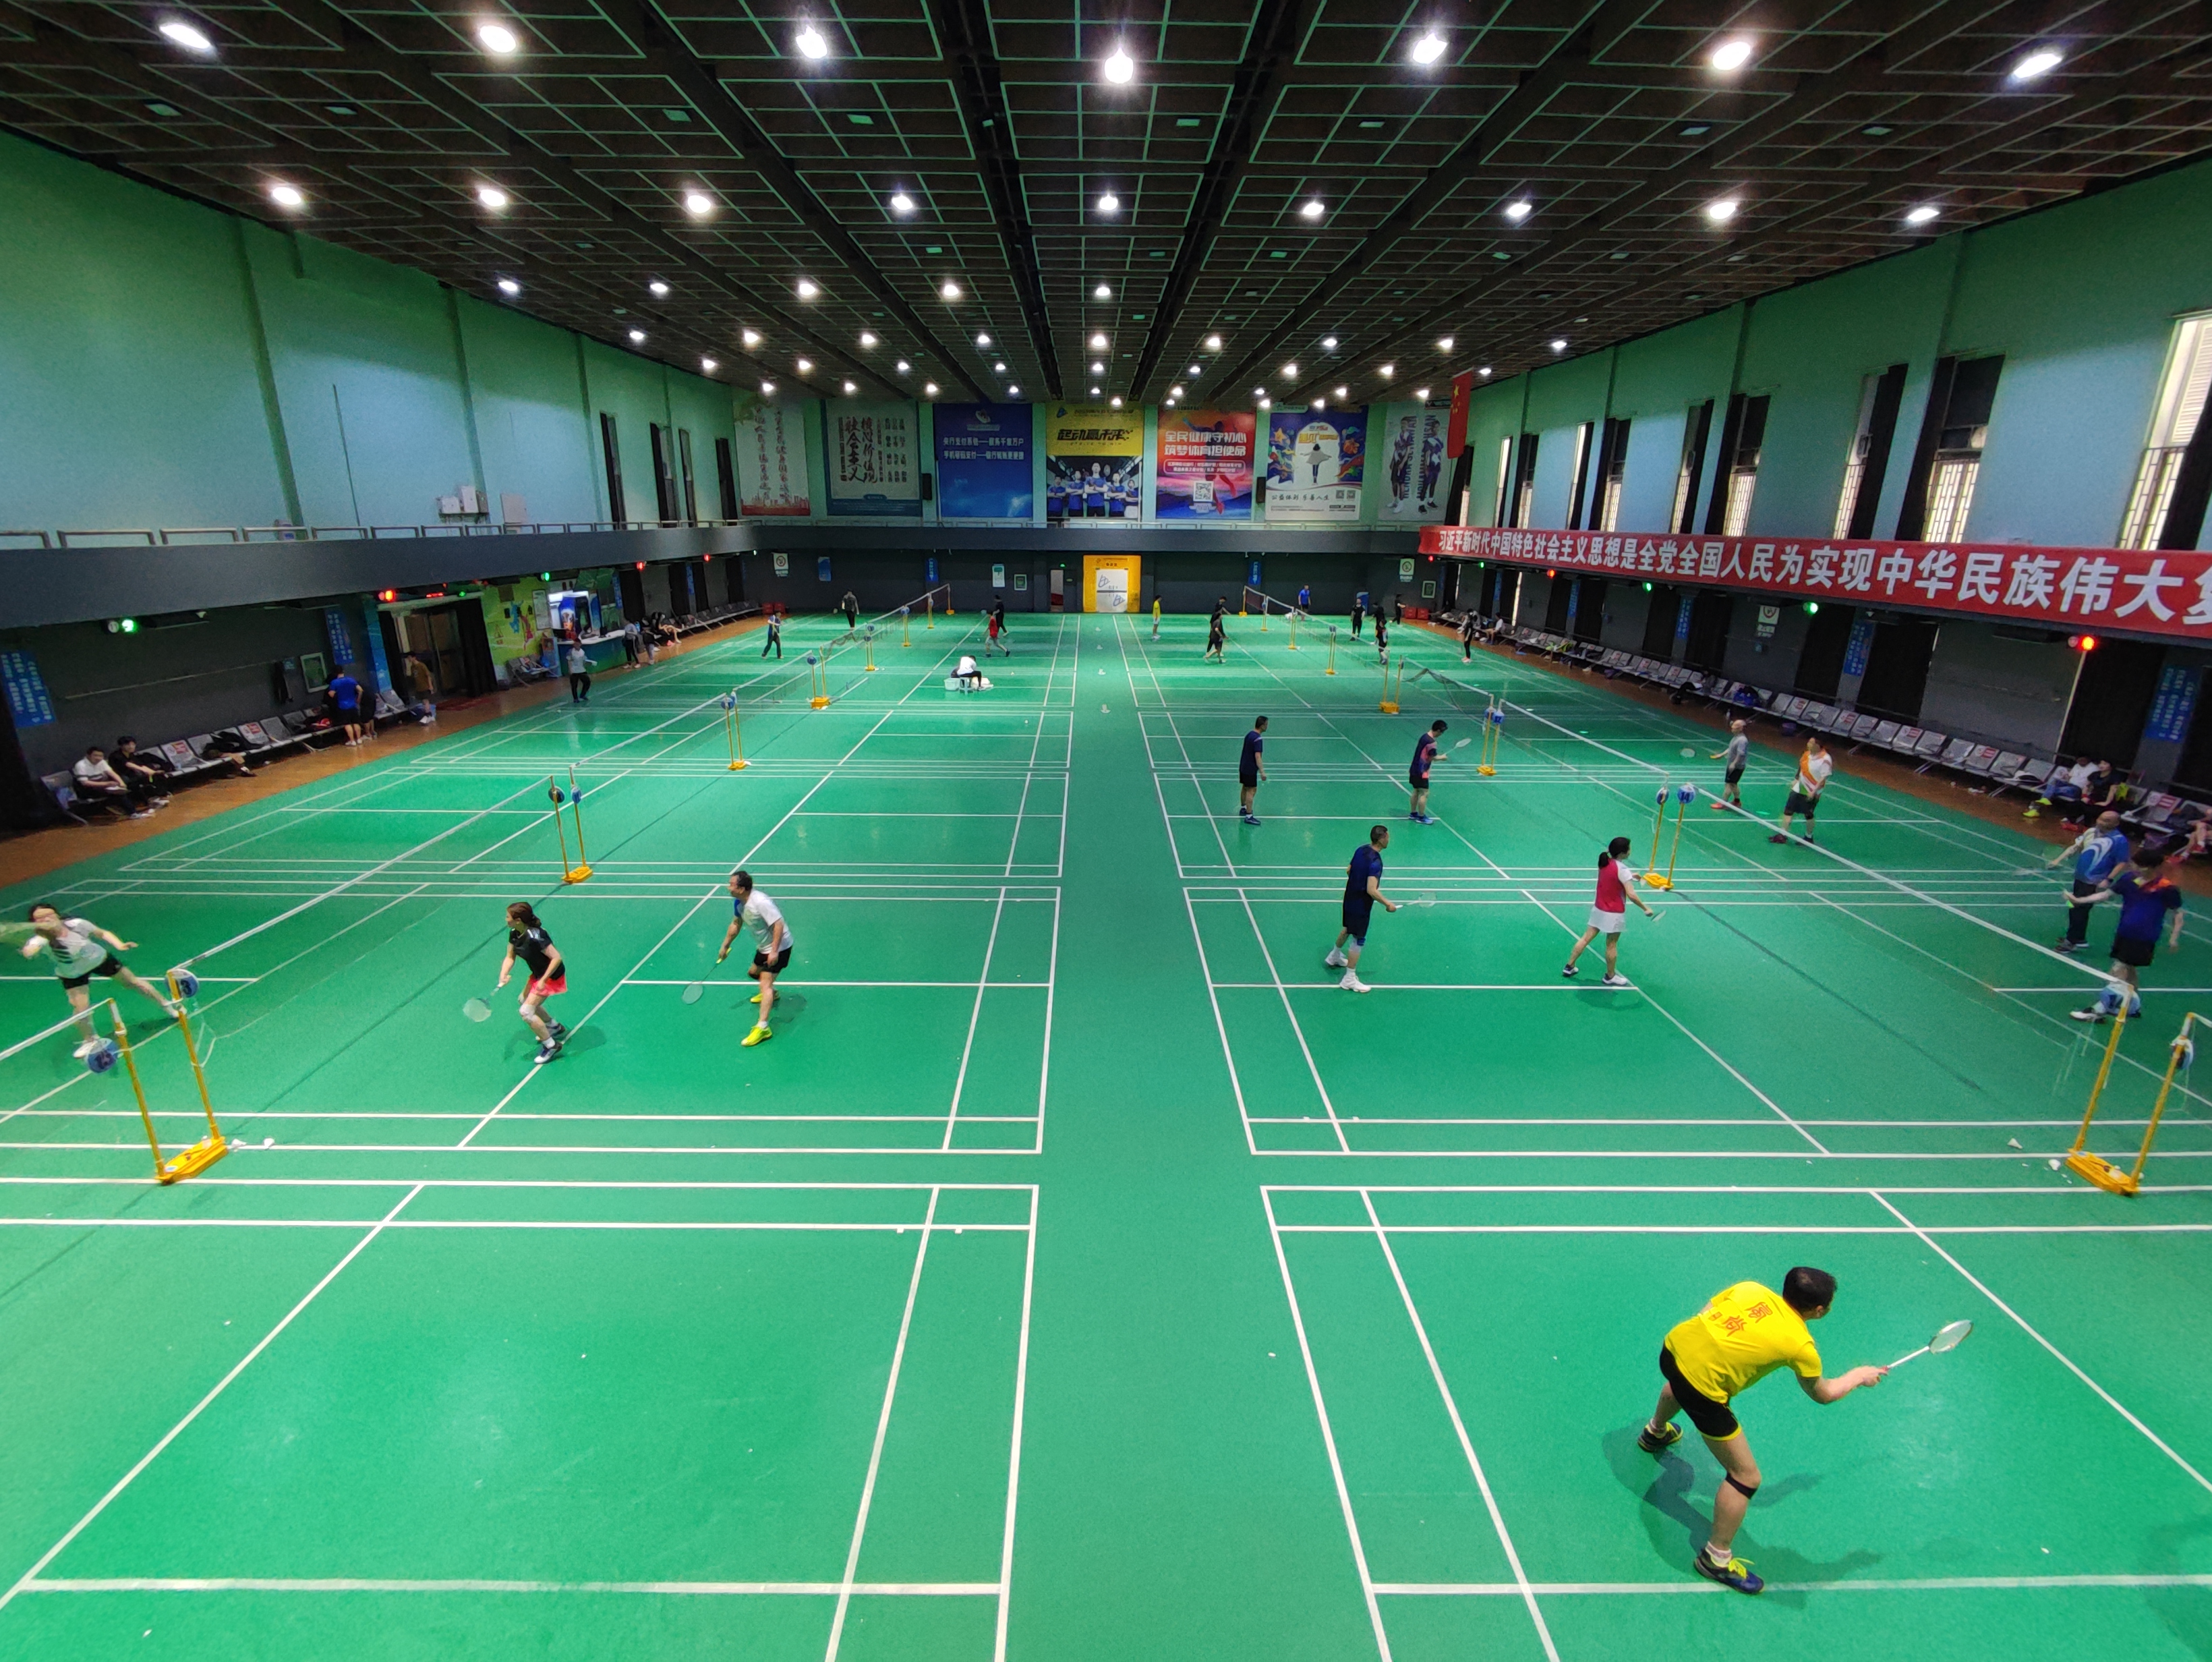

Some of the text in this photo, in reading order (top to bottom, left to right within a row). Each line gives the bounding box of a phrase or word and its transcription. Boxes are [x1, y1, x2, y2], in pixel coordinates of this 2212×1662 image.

[1165, 431, 1247, 443] 全民健康守初心
[1164, 445, 1246, 457] 筑梦体育担使命
